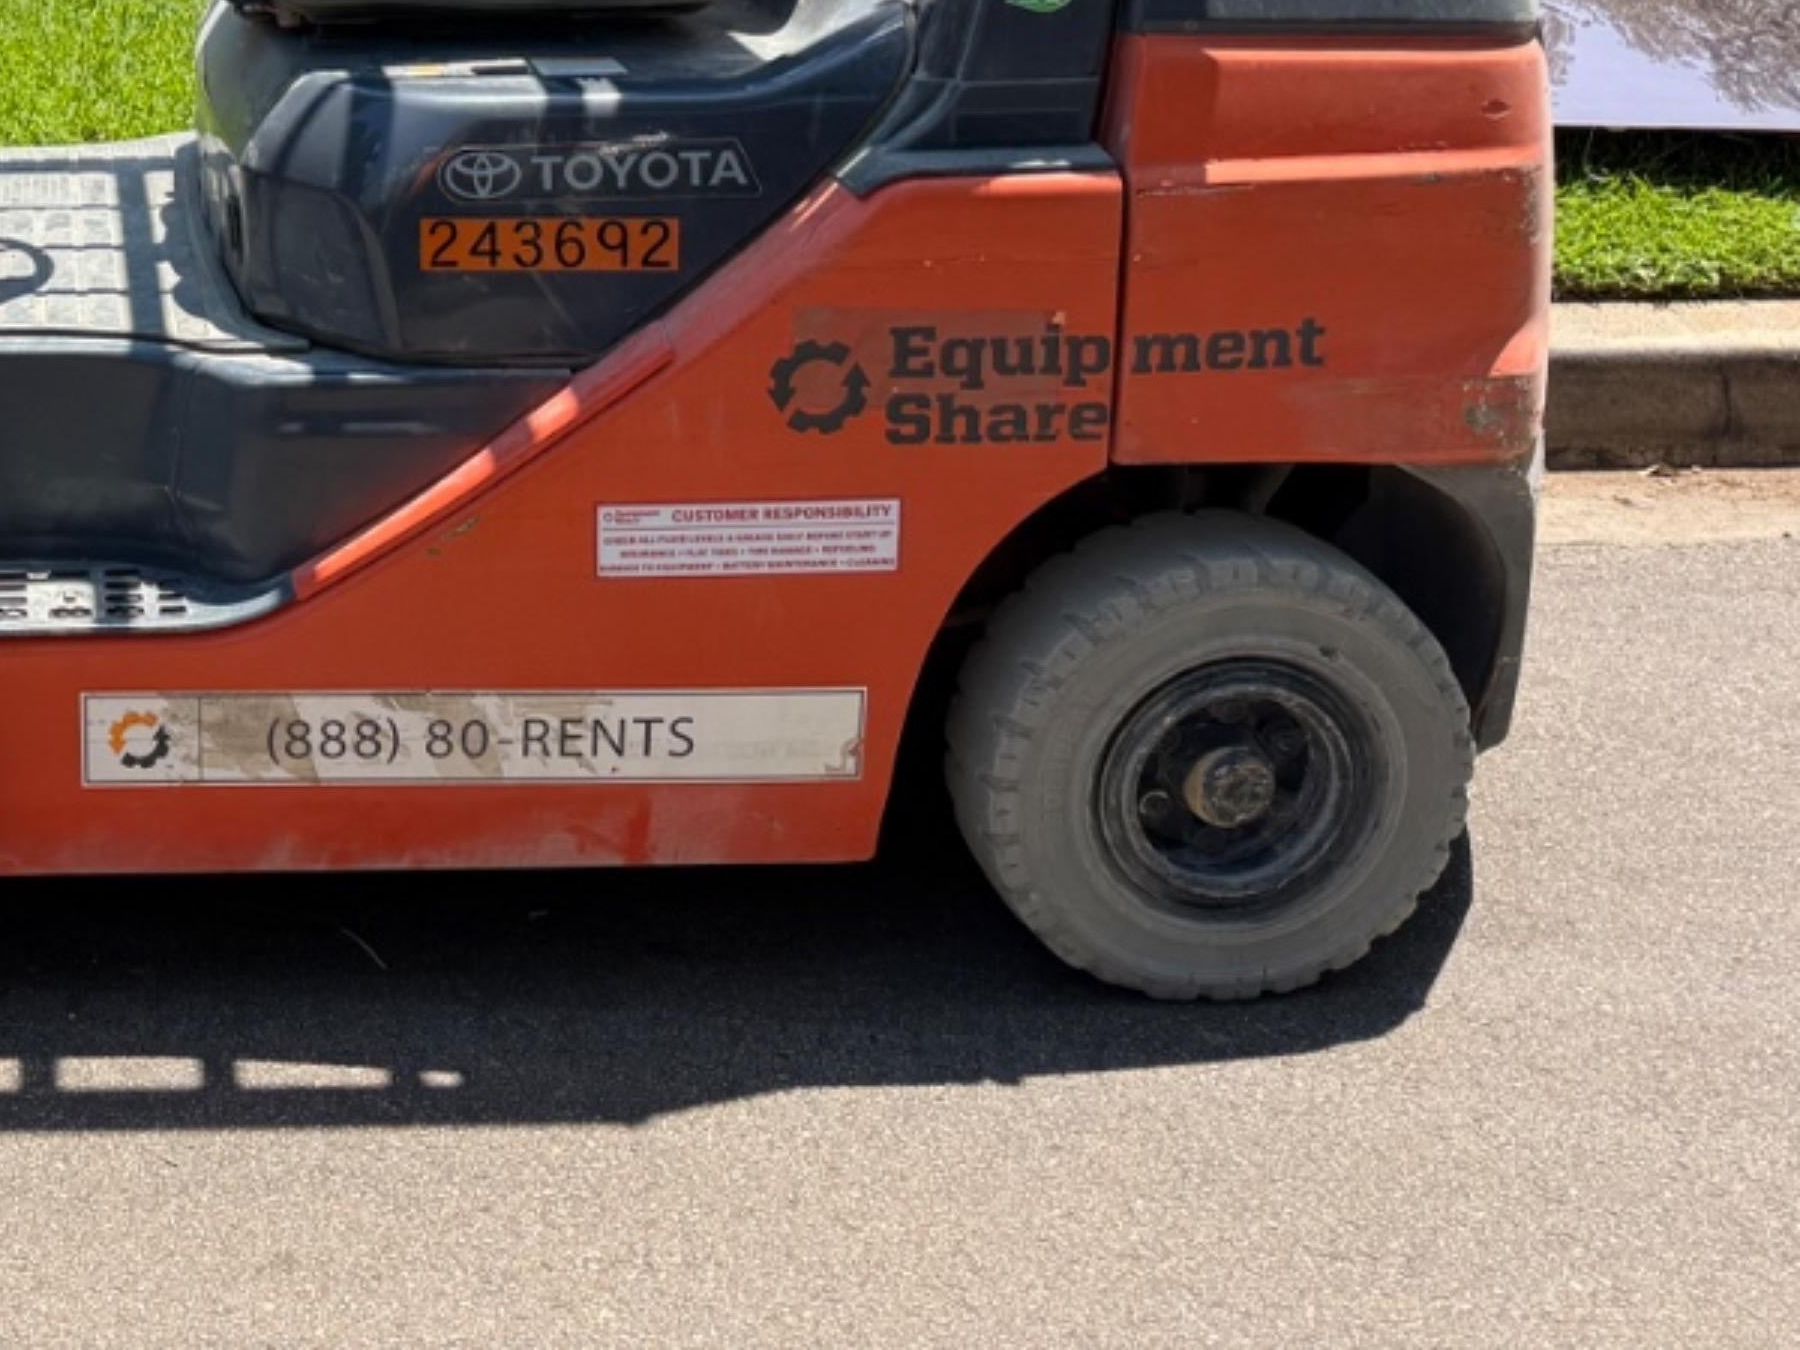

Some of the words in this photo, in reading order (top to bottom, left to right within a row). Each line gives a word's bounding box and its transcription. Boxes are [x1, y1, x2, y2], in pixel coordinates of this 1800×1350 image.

[530, 149, 749, 191] TOYOTA
[428, 220, 671, 268] 243692
[884, 393, 1109, 445] Share
[671, 507, 759, 523] CUSTOMER
[762, 503, 891, 520] RESPONSIBILITY
[266, 717, 400, 765] (888)
[425, 717, 695, 759] 80-RENTS
